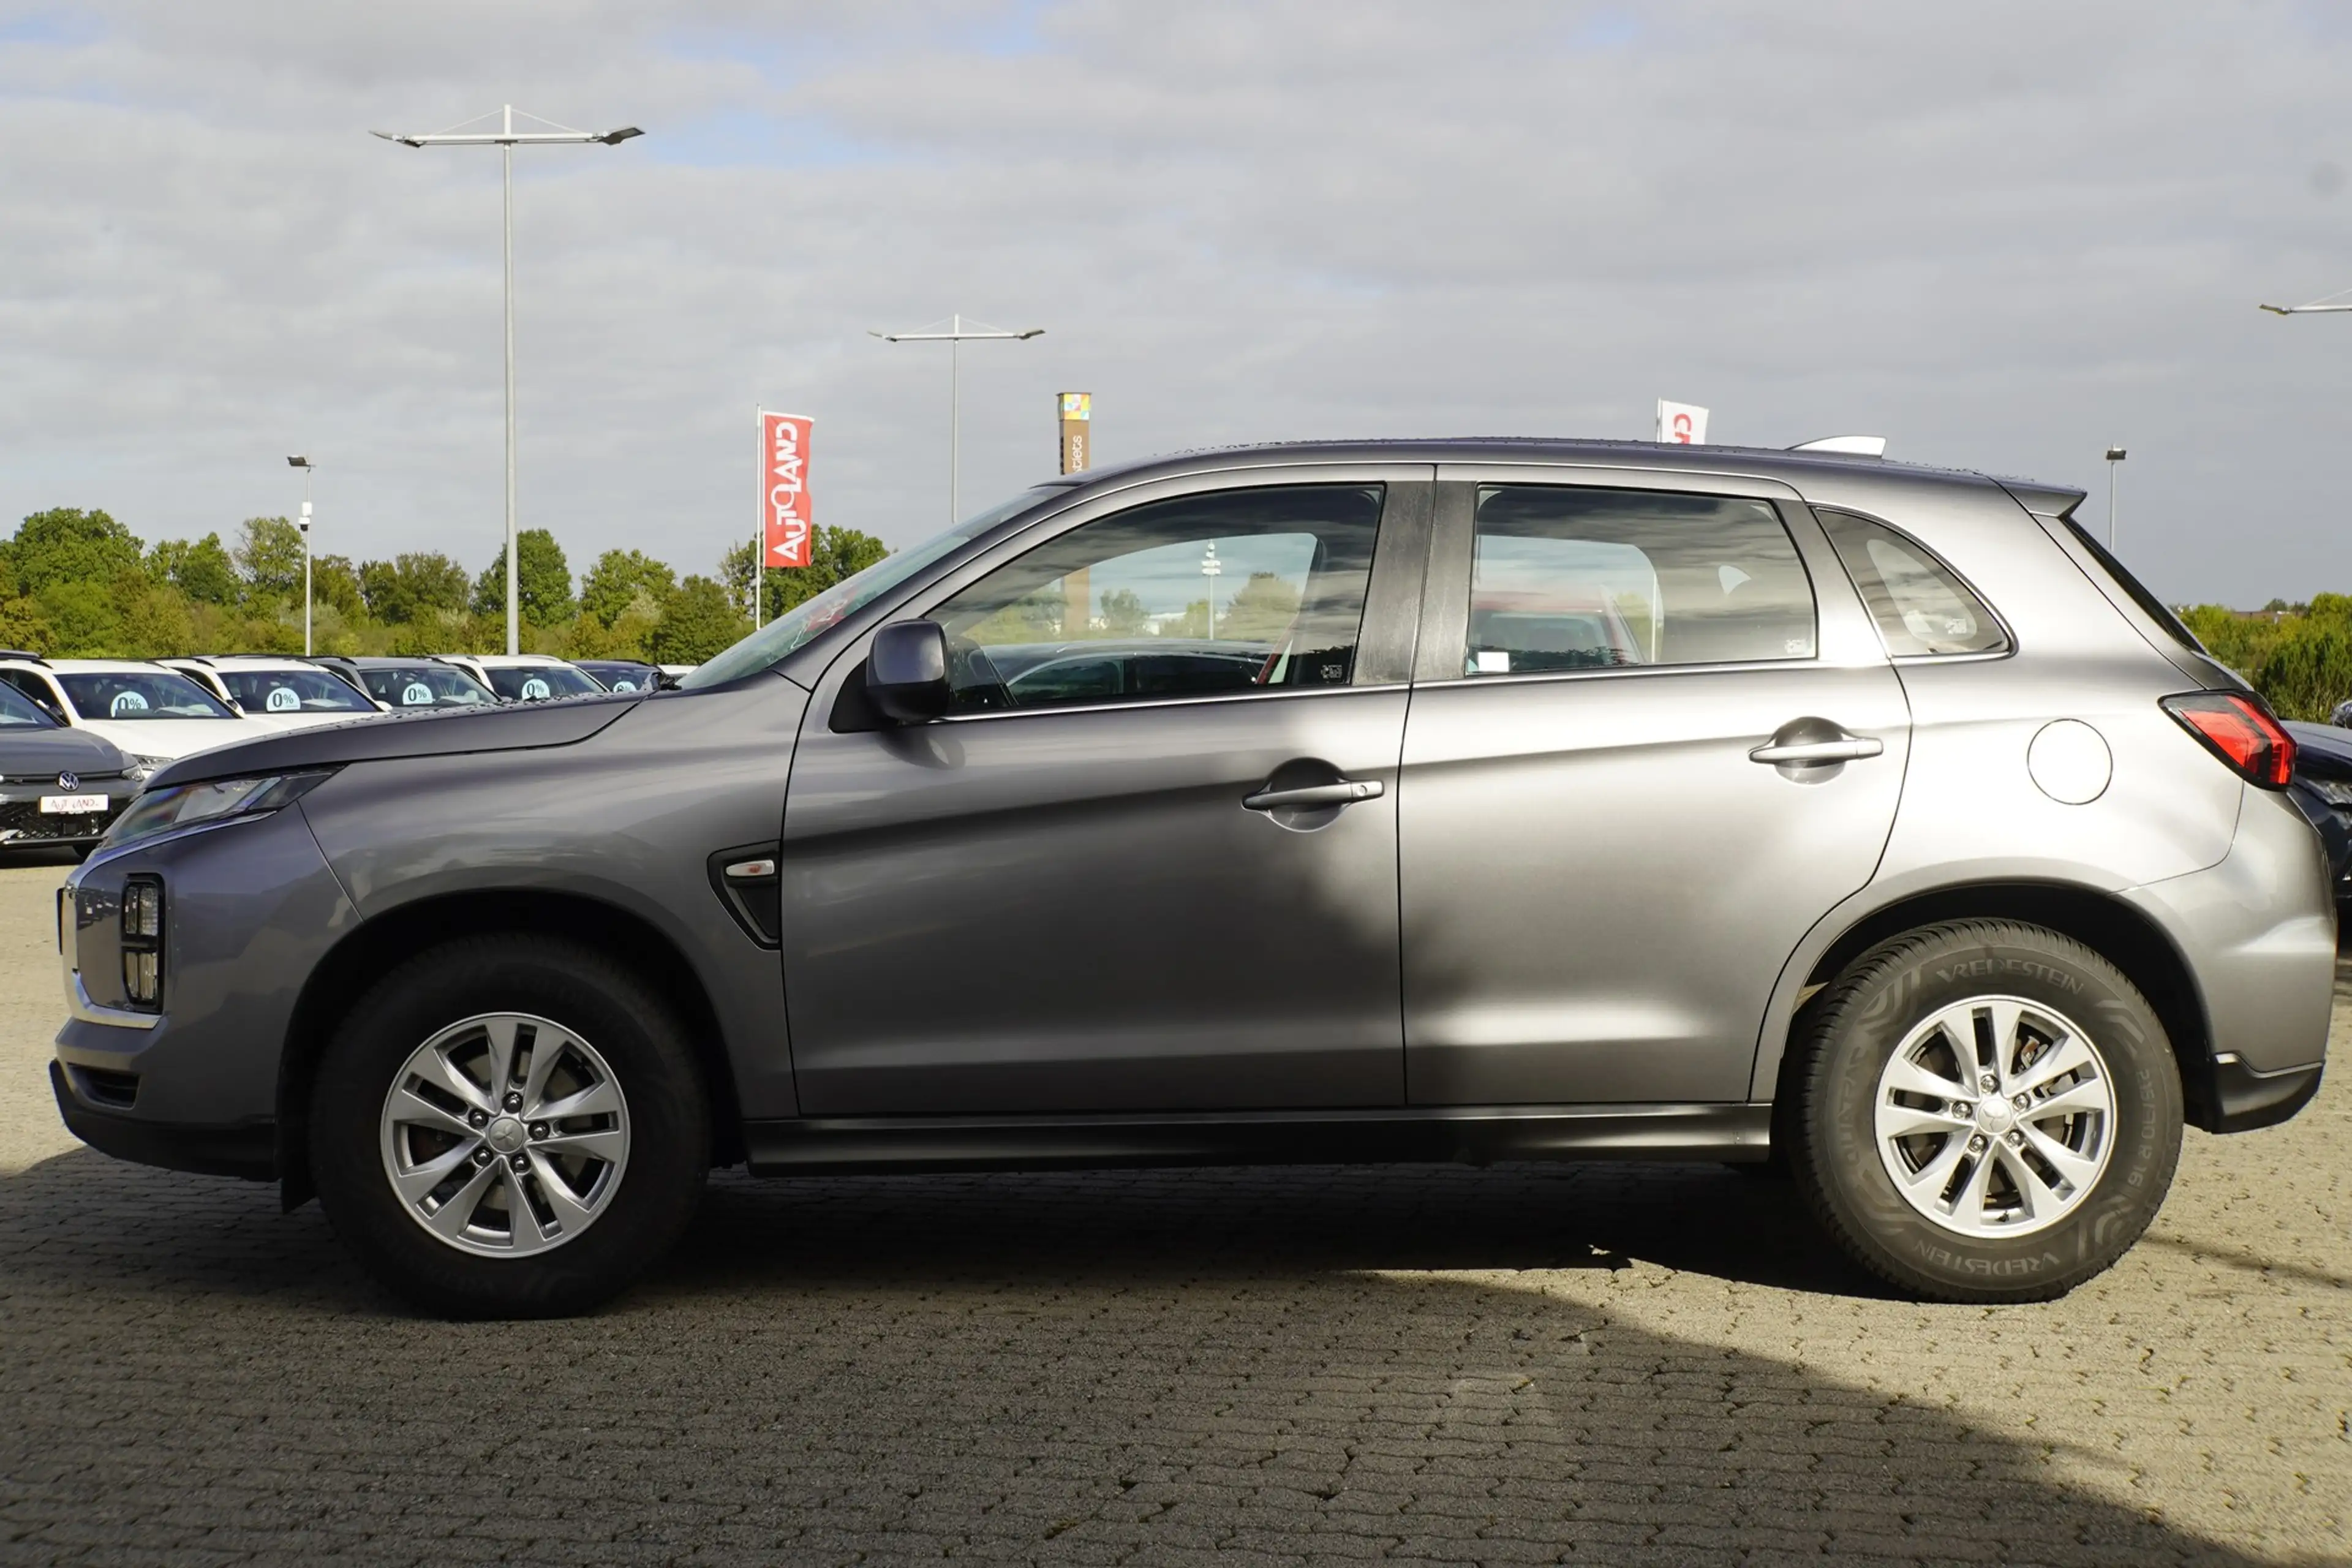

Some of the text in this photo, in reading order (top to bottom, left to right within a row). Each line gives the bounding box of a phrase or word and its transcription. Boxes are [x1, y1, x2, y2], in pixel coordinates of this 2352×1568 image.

[771, 421, 806, 561] AUTOLAND
[408, 688, 428, 702] 0%
[527, 683, 545, 695] 0%
[118, 697, 141, 709] 0%
[273, 693, 294, 707] 0%
[2127, 1164, 2147, 1187] 16
